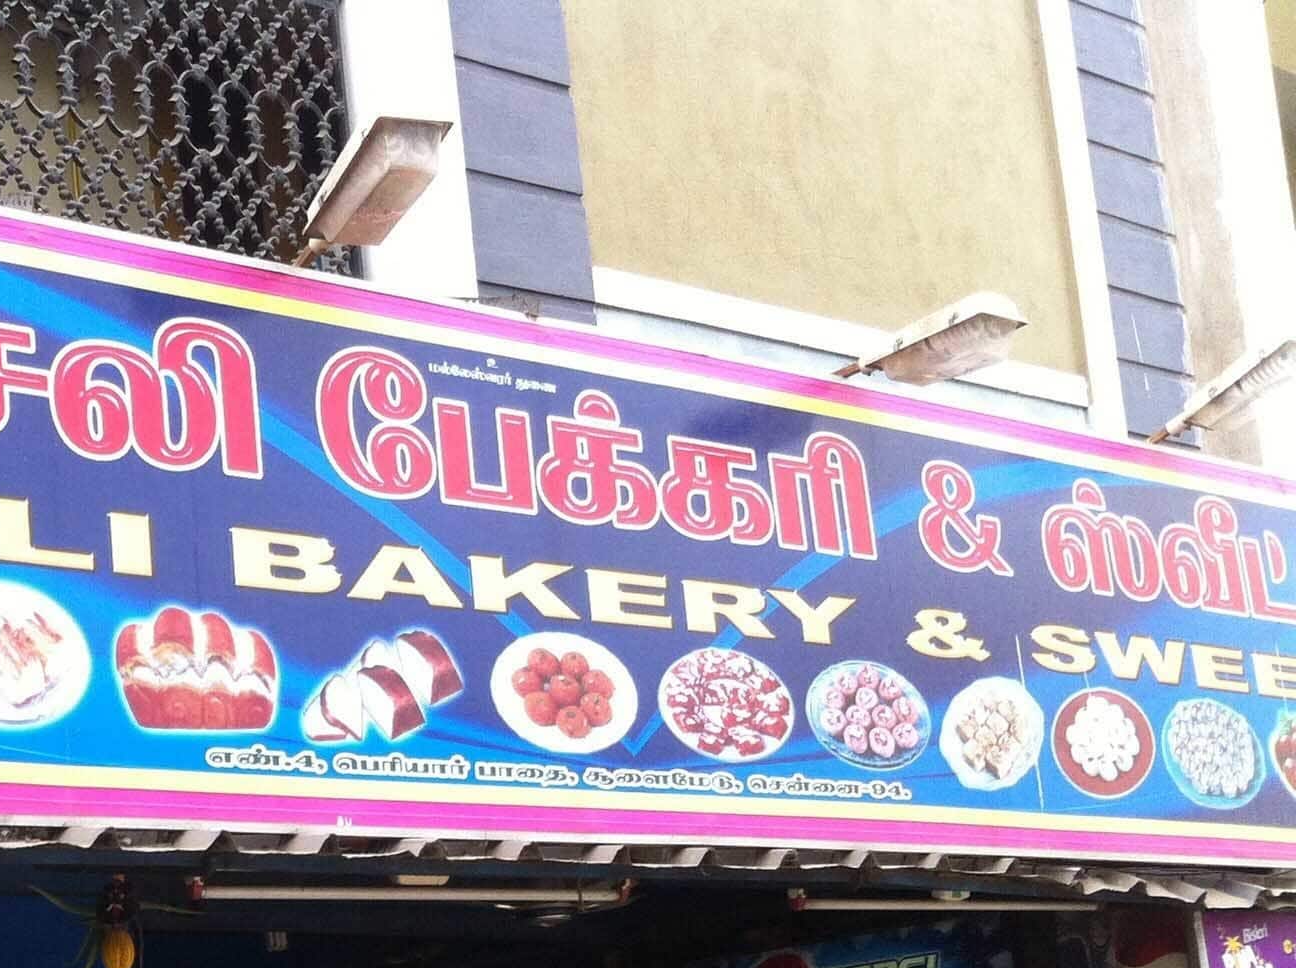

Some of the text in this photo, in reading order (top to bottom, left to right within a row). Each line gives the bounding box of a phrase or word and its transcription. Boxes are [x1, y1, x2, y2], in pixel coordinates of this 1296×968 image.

[316, 346, 880, 561] பேக்கரி
[920, 460, 1013, 578] &
[232, 526, 857, 646] BAKERY
[907, 608, 990, 665] &
